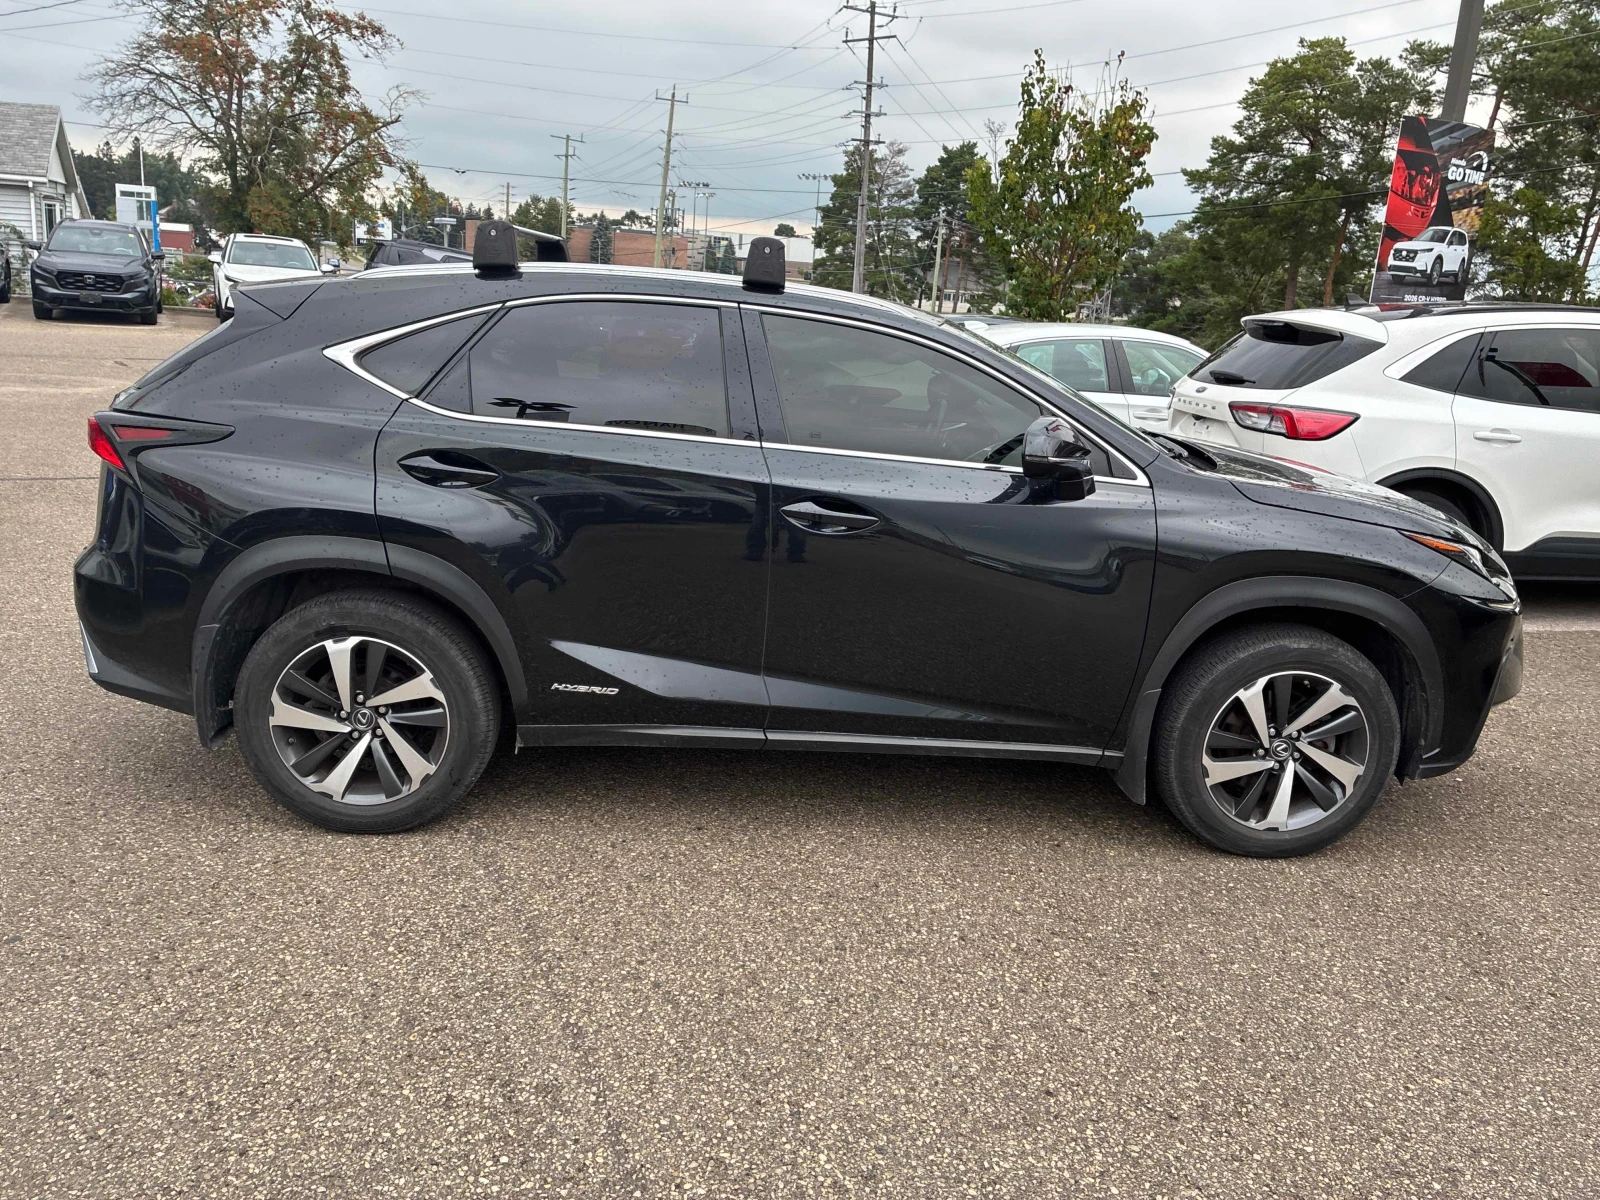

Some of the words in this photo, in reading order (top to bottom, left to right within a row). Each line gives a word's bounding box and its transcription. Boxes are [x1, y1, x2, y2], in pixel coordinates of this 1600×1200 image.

[1448, 166, 1464, 181] GO
[1464, 169, 1485, 185] TIME
[551, 683, 619, 695] HYBRID
